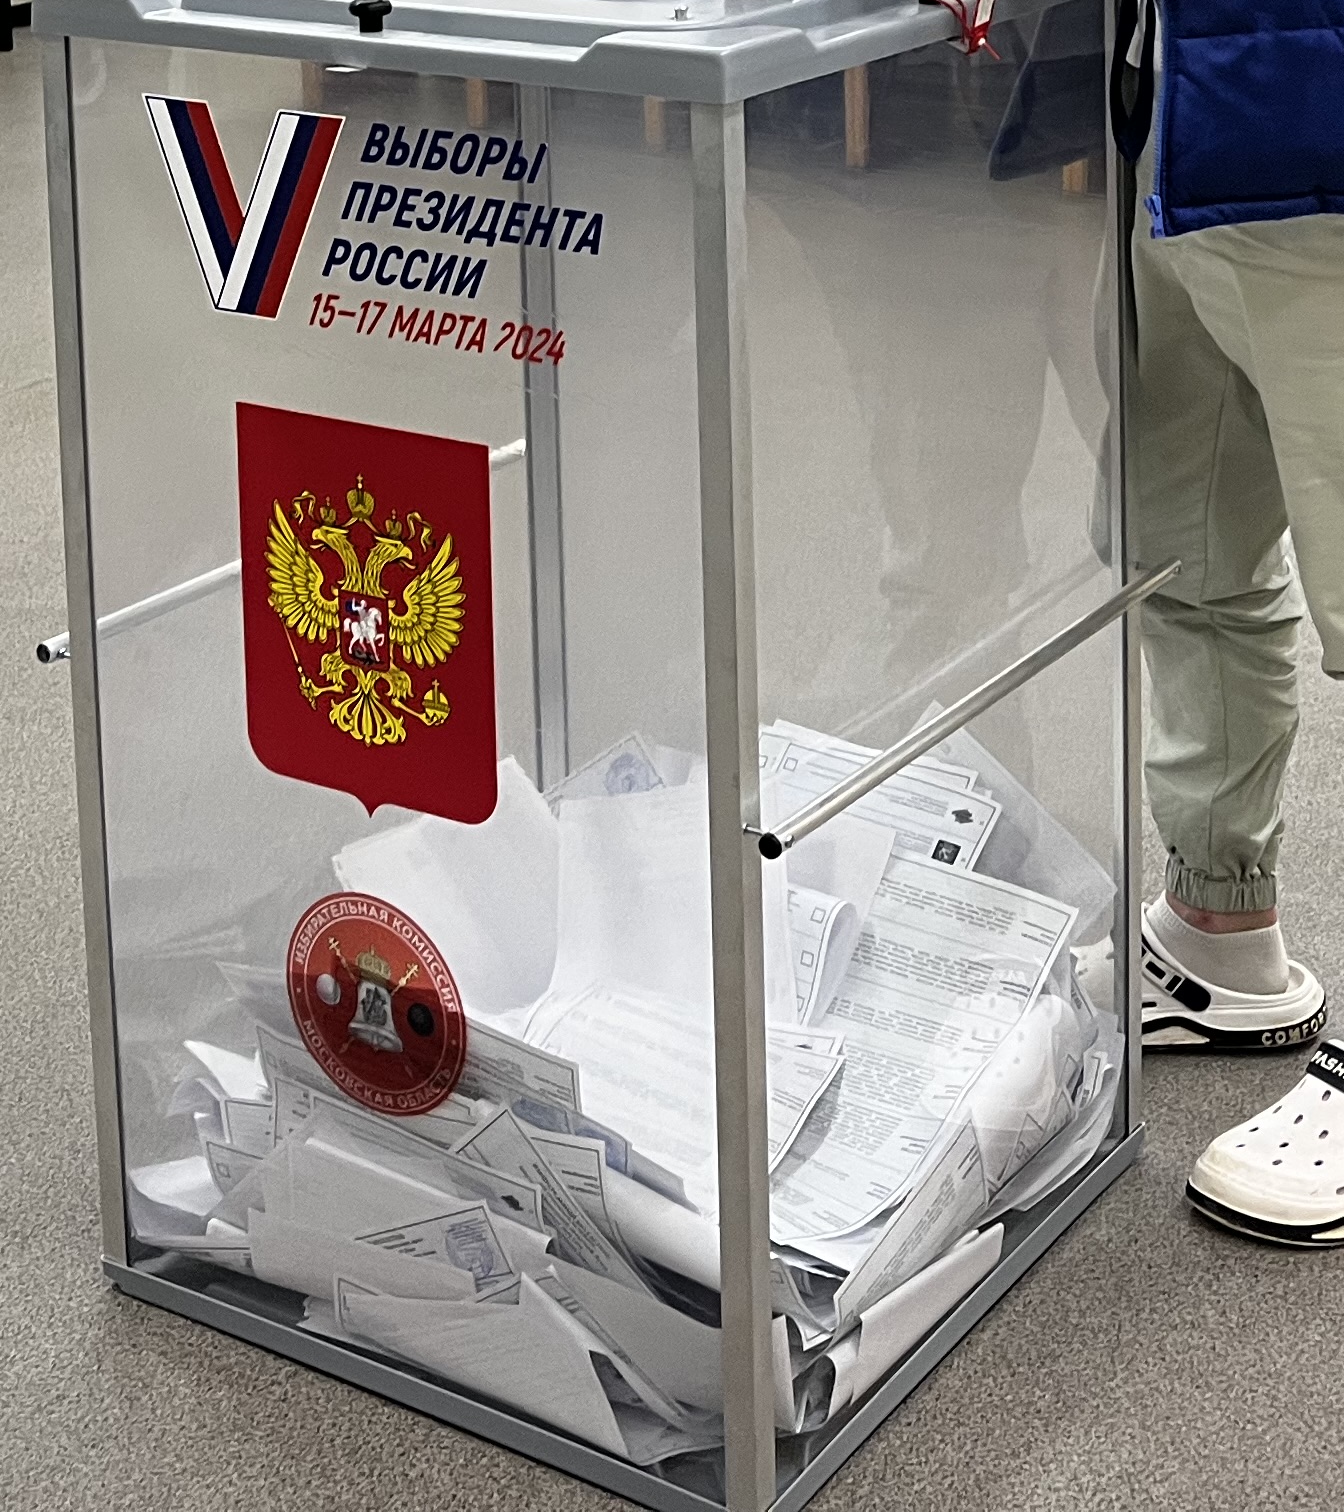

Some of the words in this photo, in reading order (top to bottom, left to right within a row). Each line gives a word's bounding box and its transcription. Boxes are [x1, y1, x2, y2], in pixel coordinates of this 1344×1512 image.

[360, 123, 548, 184] ВЫБОРЫ
[340, 181, 605, 255] ПРЕЗИДЕНТА
[321, 238, 488, 299] РОССИИ
[388, 305, 487, 354] МАРТА
[493, 322, 567, 367] 2024
[293, 900, 389, 965] ИЗБИРАТЕЛЬНАЯ
[391, 916, 457, 1013] КОМИССИЯ
[1261, 1006, 1326, 1047] COMFOR
[303, 1019, 394, 1107] МОСКОВСКАЯ
[397, 1068, 451, 1108] ОБЛАСТЬ
